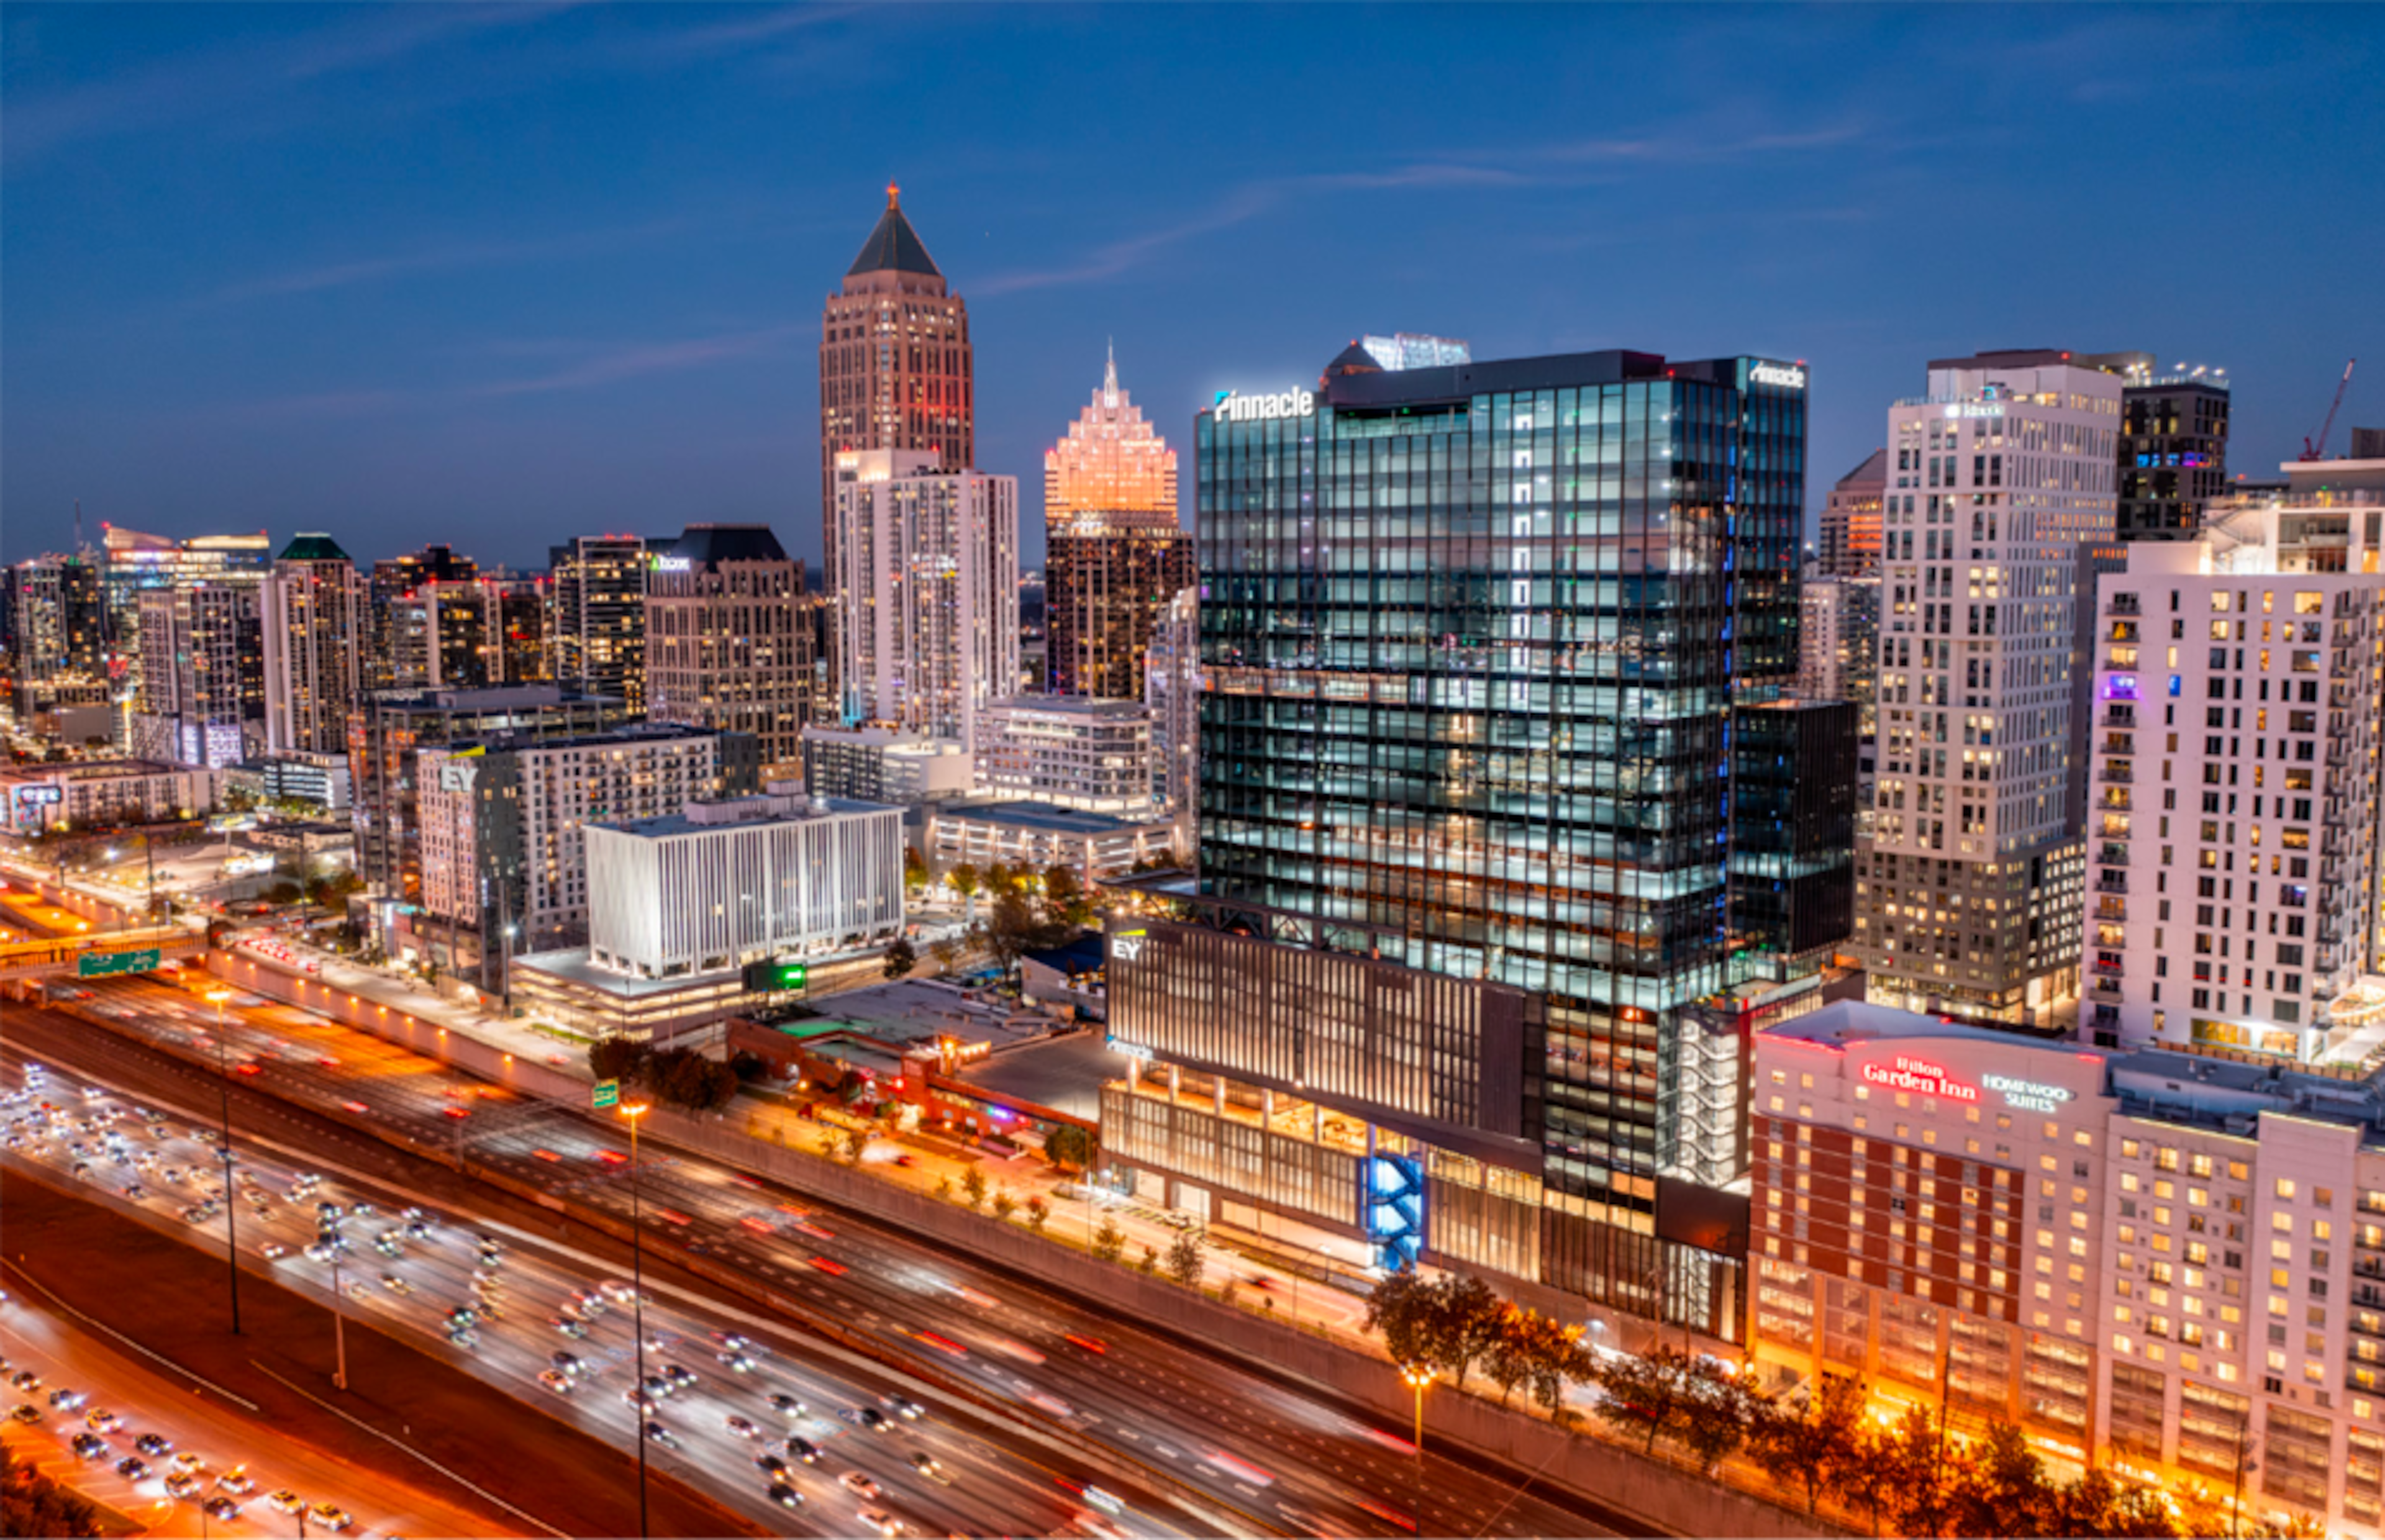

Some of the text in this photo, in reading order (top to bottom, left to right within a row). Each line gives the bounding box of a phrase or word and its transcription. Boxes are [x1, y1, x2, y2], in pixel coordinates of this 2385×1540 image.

[1215, 385, 1314, 423] Pinnacle
[441, 766, 479, 792] EY
[1112, 938, 1141, 961] EY
[1896, 1057, 1943, 1078] Hilton
[1863, 1064, 1976, 1100] Garden Inn
[2004, 1092, 2056, 1114] SUITES
